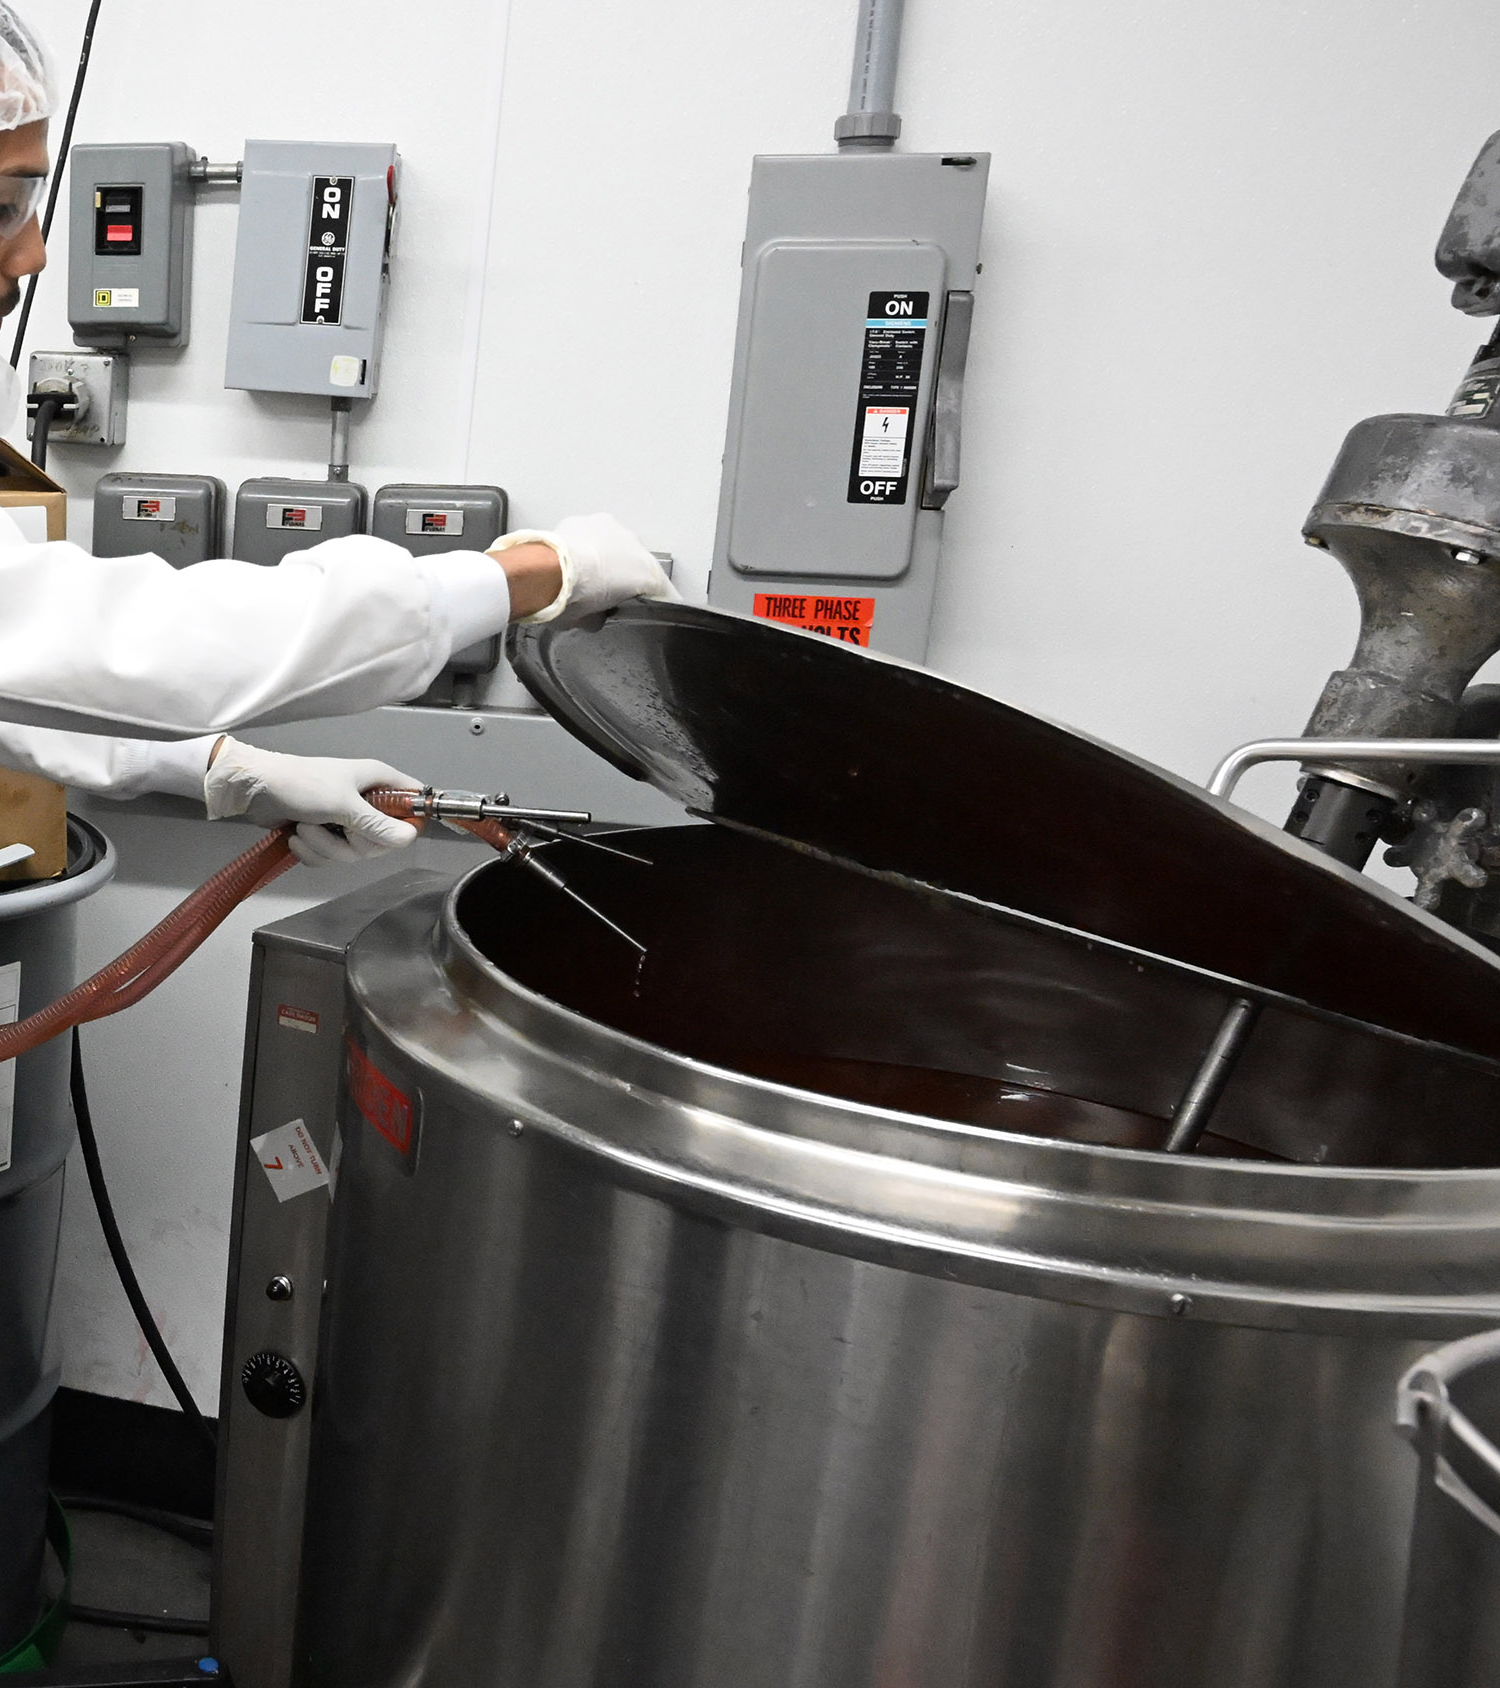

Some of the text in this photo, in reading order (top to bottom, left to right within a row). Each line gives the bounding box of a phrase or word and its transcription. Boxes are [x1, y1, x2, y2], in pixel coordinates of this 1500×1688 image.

[322, 187, 341, 219] ON
[314, 266, 334, 313] OFF
[885, 300, 913, 316] ON
[860, 480, 898, 495] OFF
[765, 597, 861, 621] THREE PHASE
[288, 1144, 305, 1168] ABOVE
[295, 1126, 323, 1174] DO NOT TURN
[263, 1156, 283, 1170] 7
